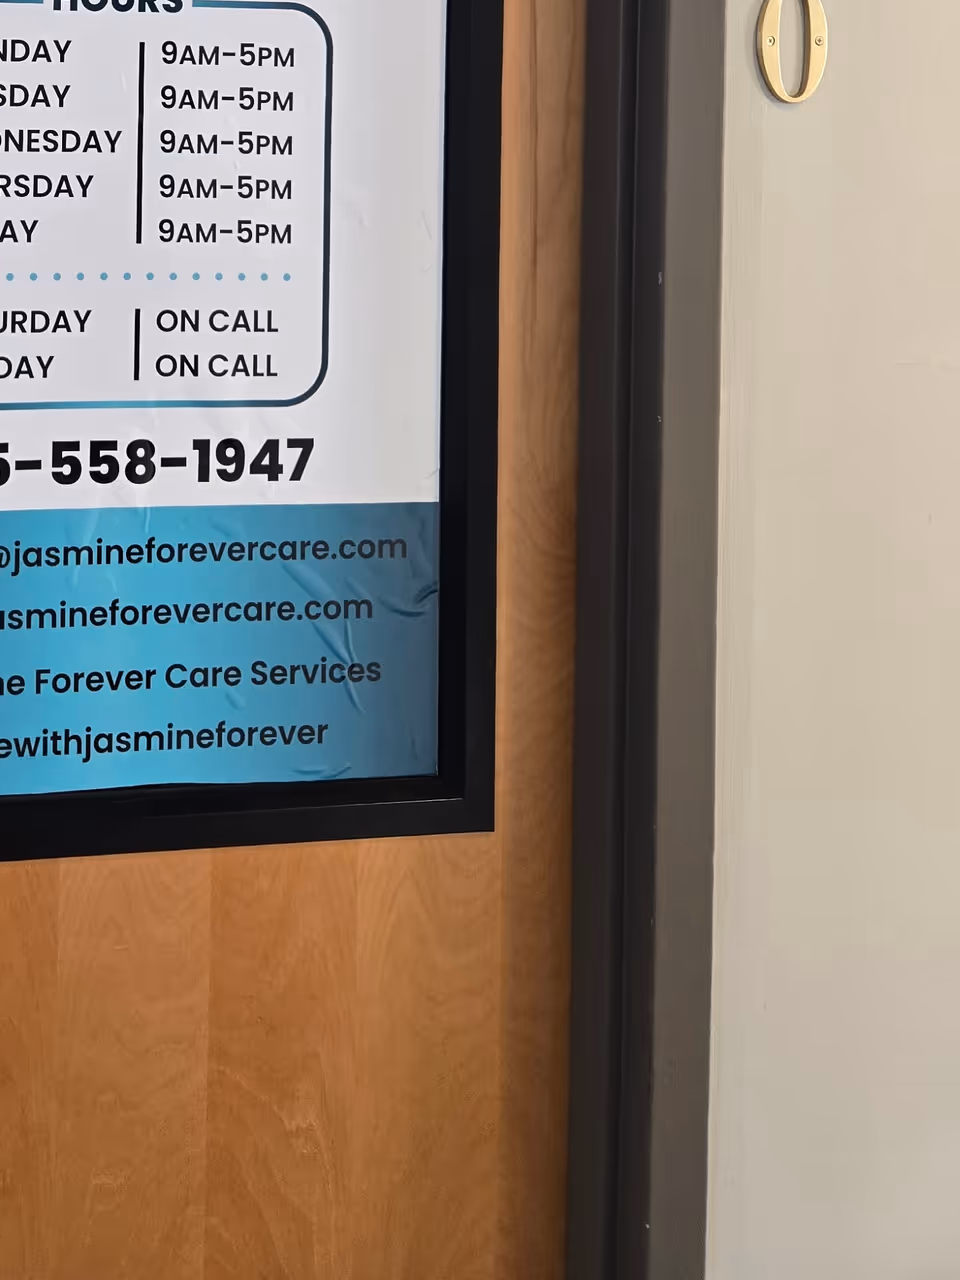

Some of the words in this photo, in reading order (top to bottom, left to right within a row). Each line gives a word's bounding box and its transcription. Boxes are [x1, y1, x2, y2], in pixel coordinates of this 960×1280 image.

[161, 41, 295, 67] 9AM-5PM
[160, 86, 294, 111] 9AM-5PM
[160, 130, 293, 155] 9AM-5PM
[159, 174, 292, 199] 9AM-5PM
[158, 219, 292, 244] 9AM-5PM
[156, 309, 200, 333] ON
[208, 309, 278, 333] CALL
[155, 354, 199, 377] ON
[208, 354, 277, 377] CALL
[34, 665, 156, 695] Forever
[165, 662, 241, 689] Care
[250, 656, 382, 685] Services
